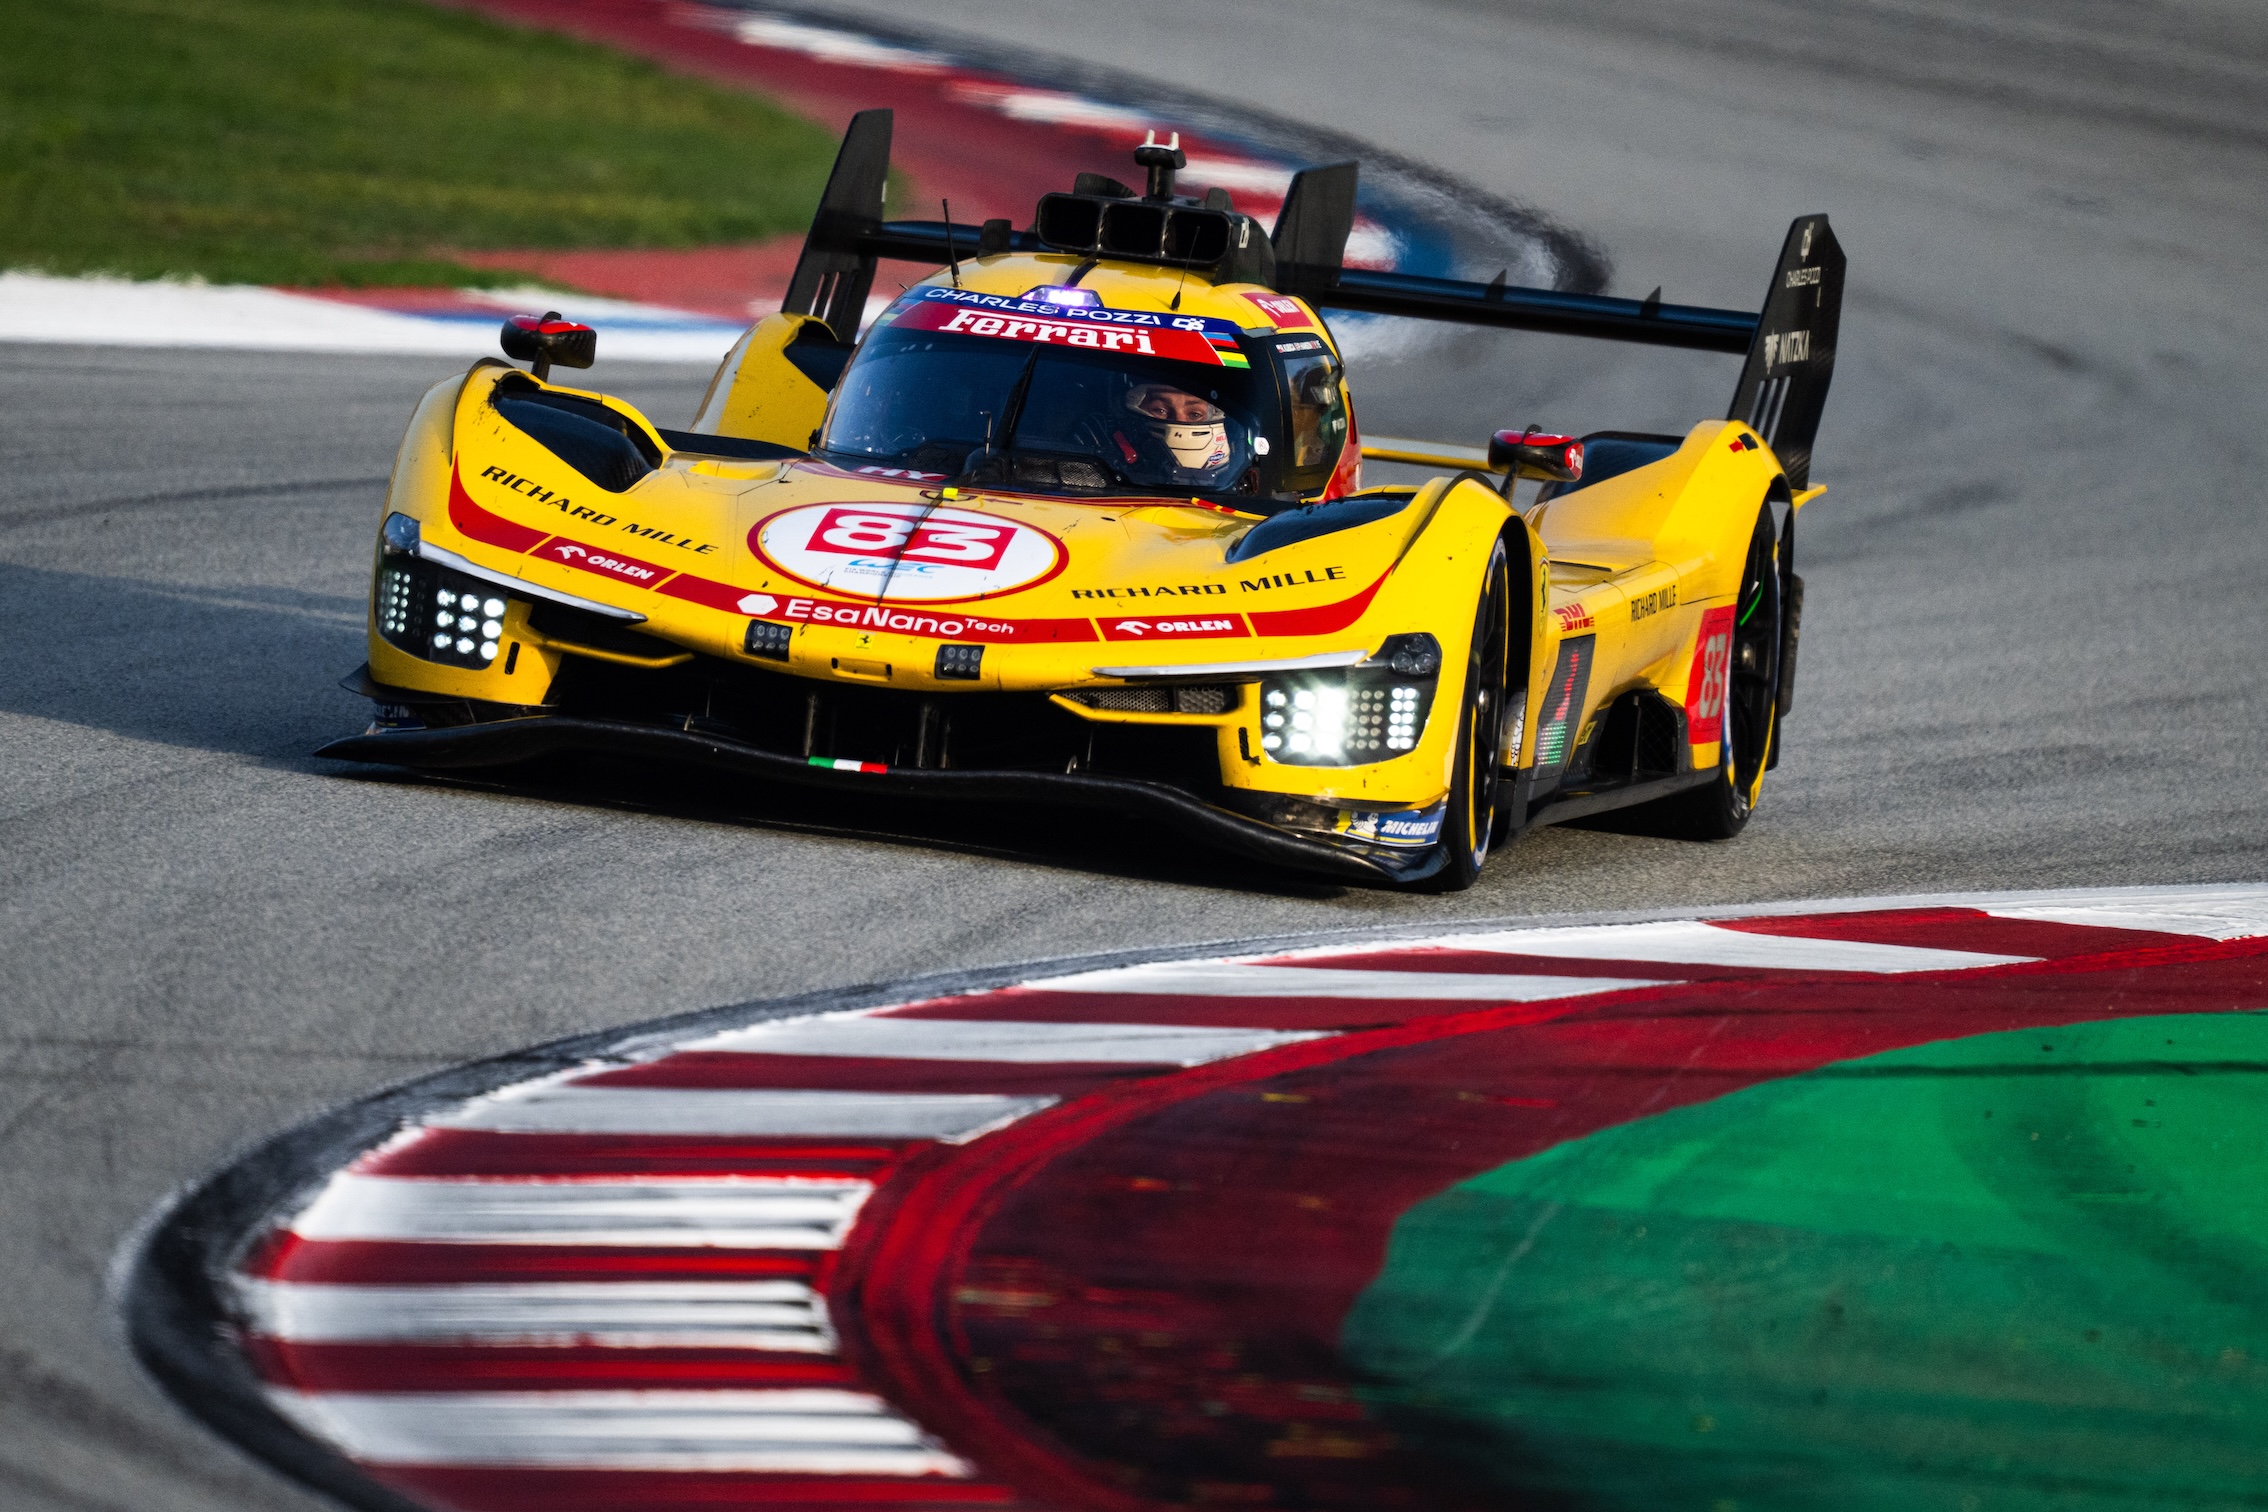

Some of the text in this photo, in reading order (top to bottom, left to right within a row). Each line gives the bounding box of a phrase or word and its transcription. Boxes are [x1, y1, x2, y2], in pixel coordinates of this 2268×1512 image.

[925, 288, 1057, 314] CHARLES
[1067, 308, 1161, 325] POZZI
[938, 308, 1156, 355] Ferrari
[480, 465, 719, 555] RICHARD MILLE
[822, 514, 1001, 561] 83
[587, 555, 655, 580] ORLEN
[1071, 566, 1347, 599] RICHARD MILLE
[1631, 592, 1657, 622] RICHARD
[1156, 619, 1233, 633] ORLEN
[1699, 633, 1727, 719] 83
[1380, 819, 1439, 836] MICHELIN
